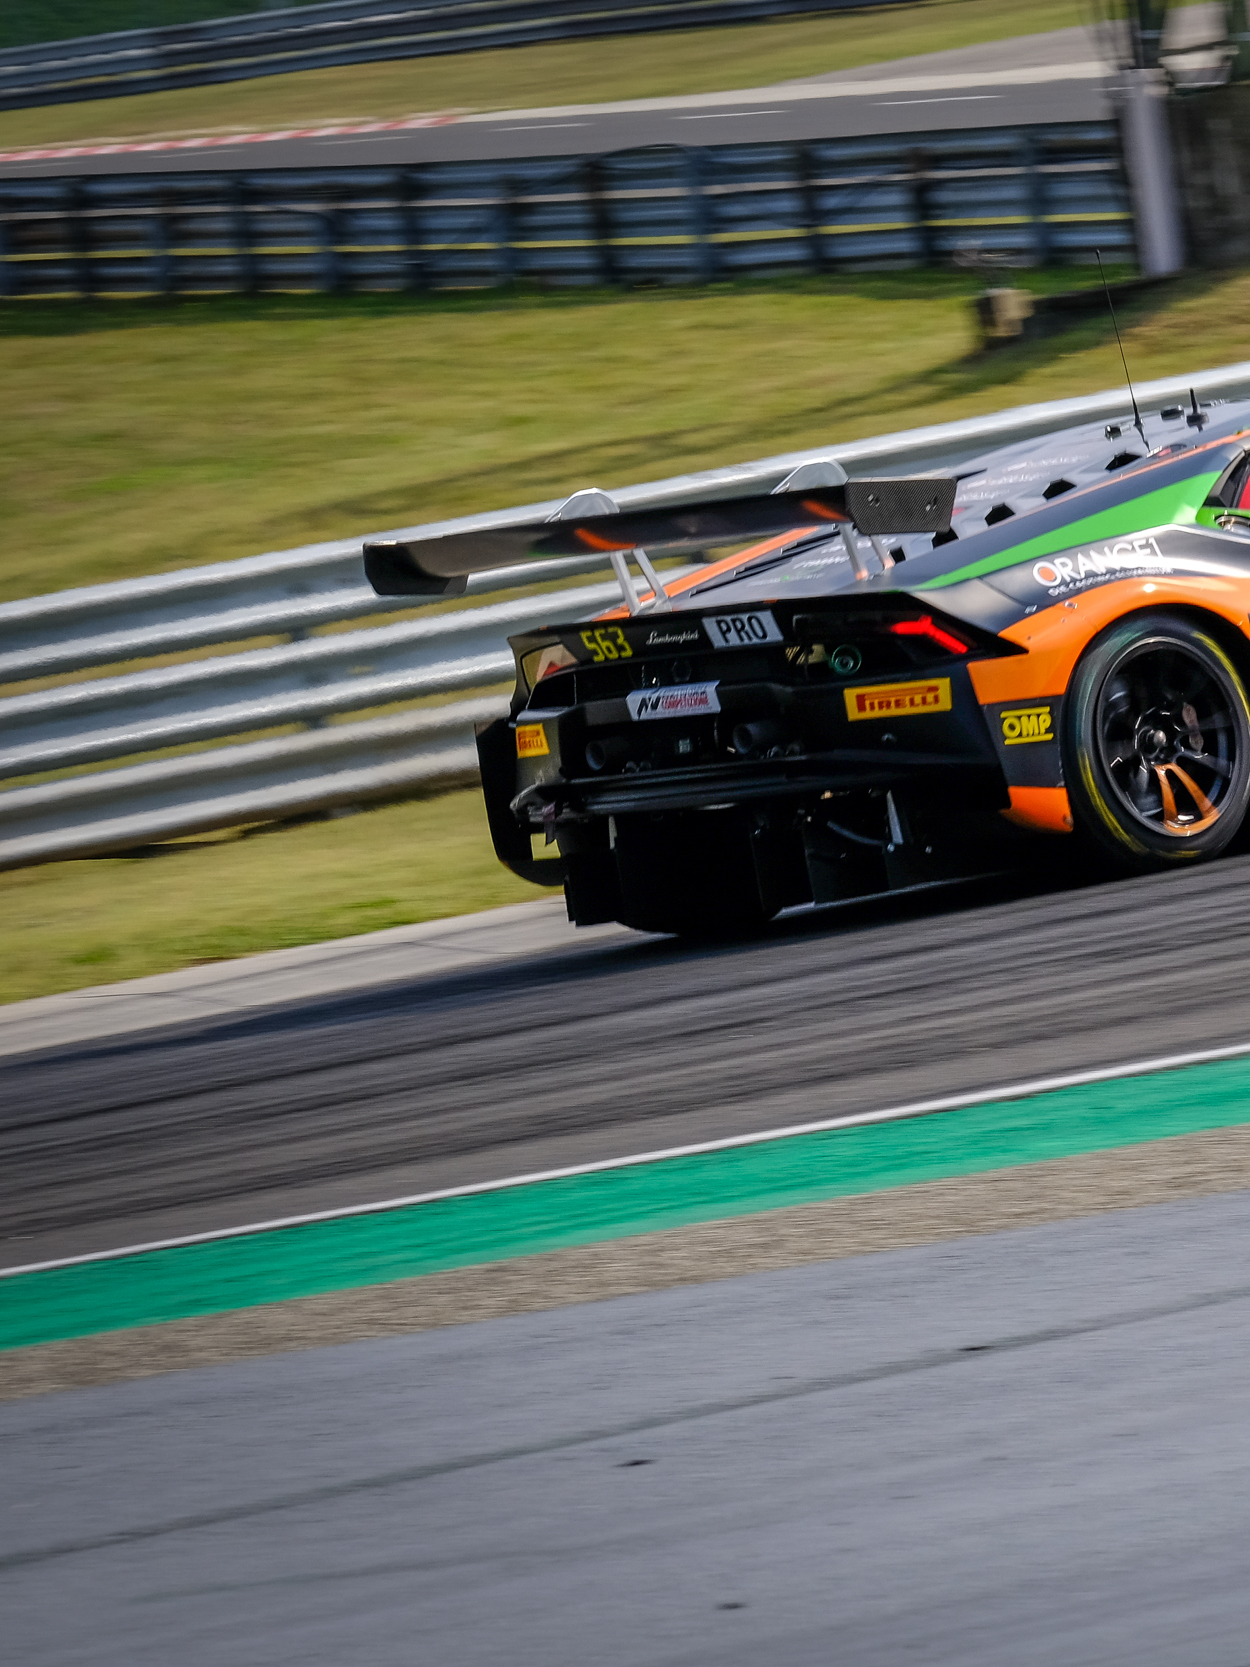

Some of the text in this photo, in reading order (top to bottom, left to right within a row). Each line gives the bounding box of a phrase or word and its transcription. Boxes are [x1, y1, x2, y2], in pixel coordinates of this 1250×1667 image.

[716, 615, 768, 644] PRO
[580, 627, 633, 663] 563
[855, 685, 940, 714] PIRELLI
[1002, 711, 1052, 739] OMP
